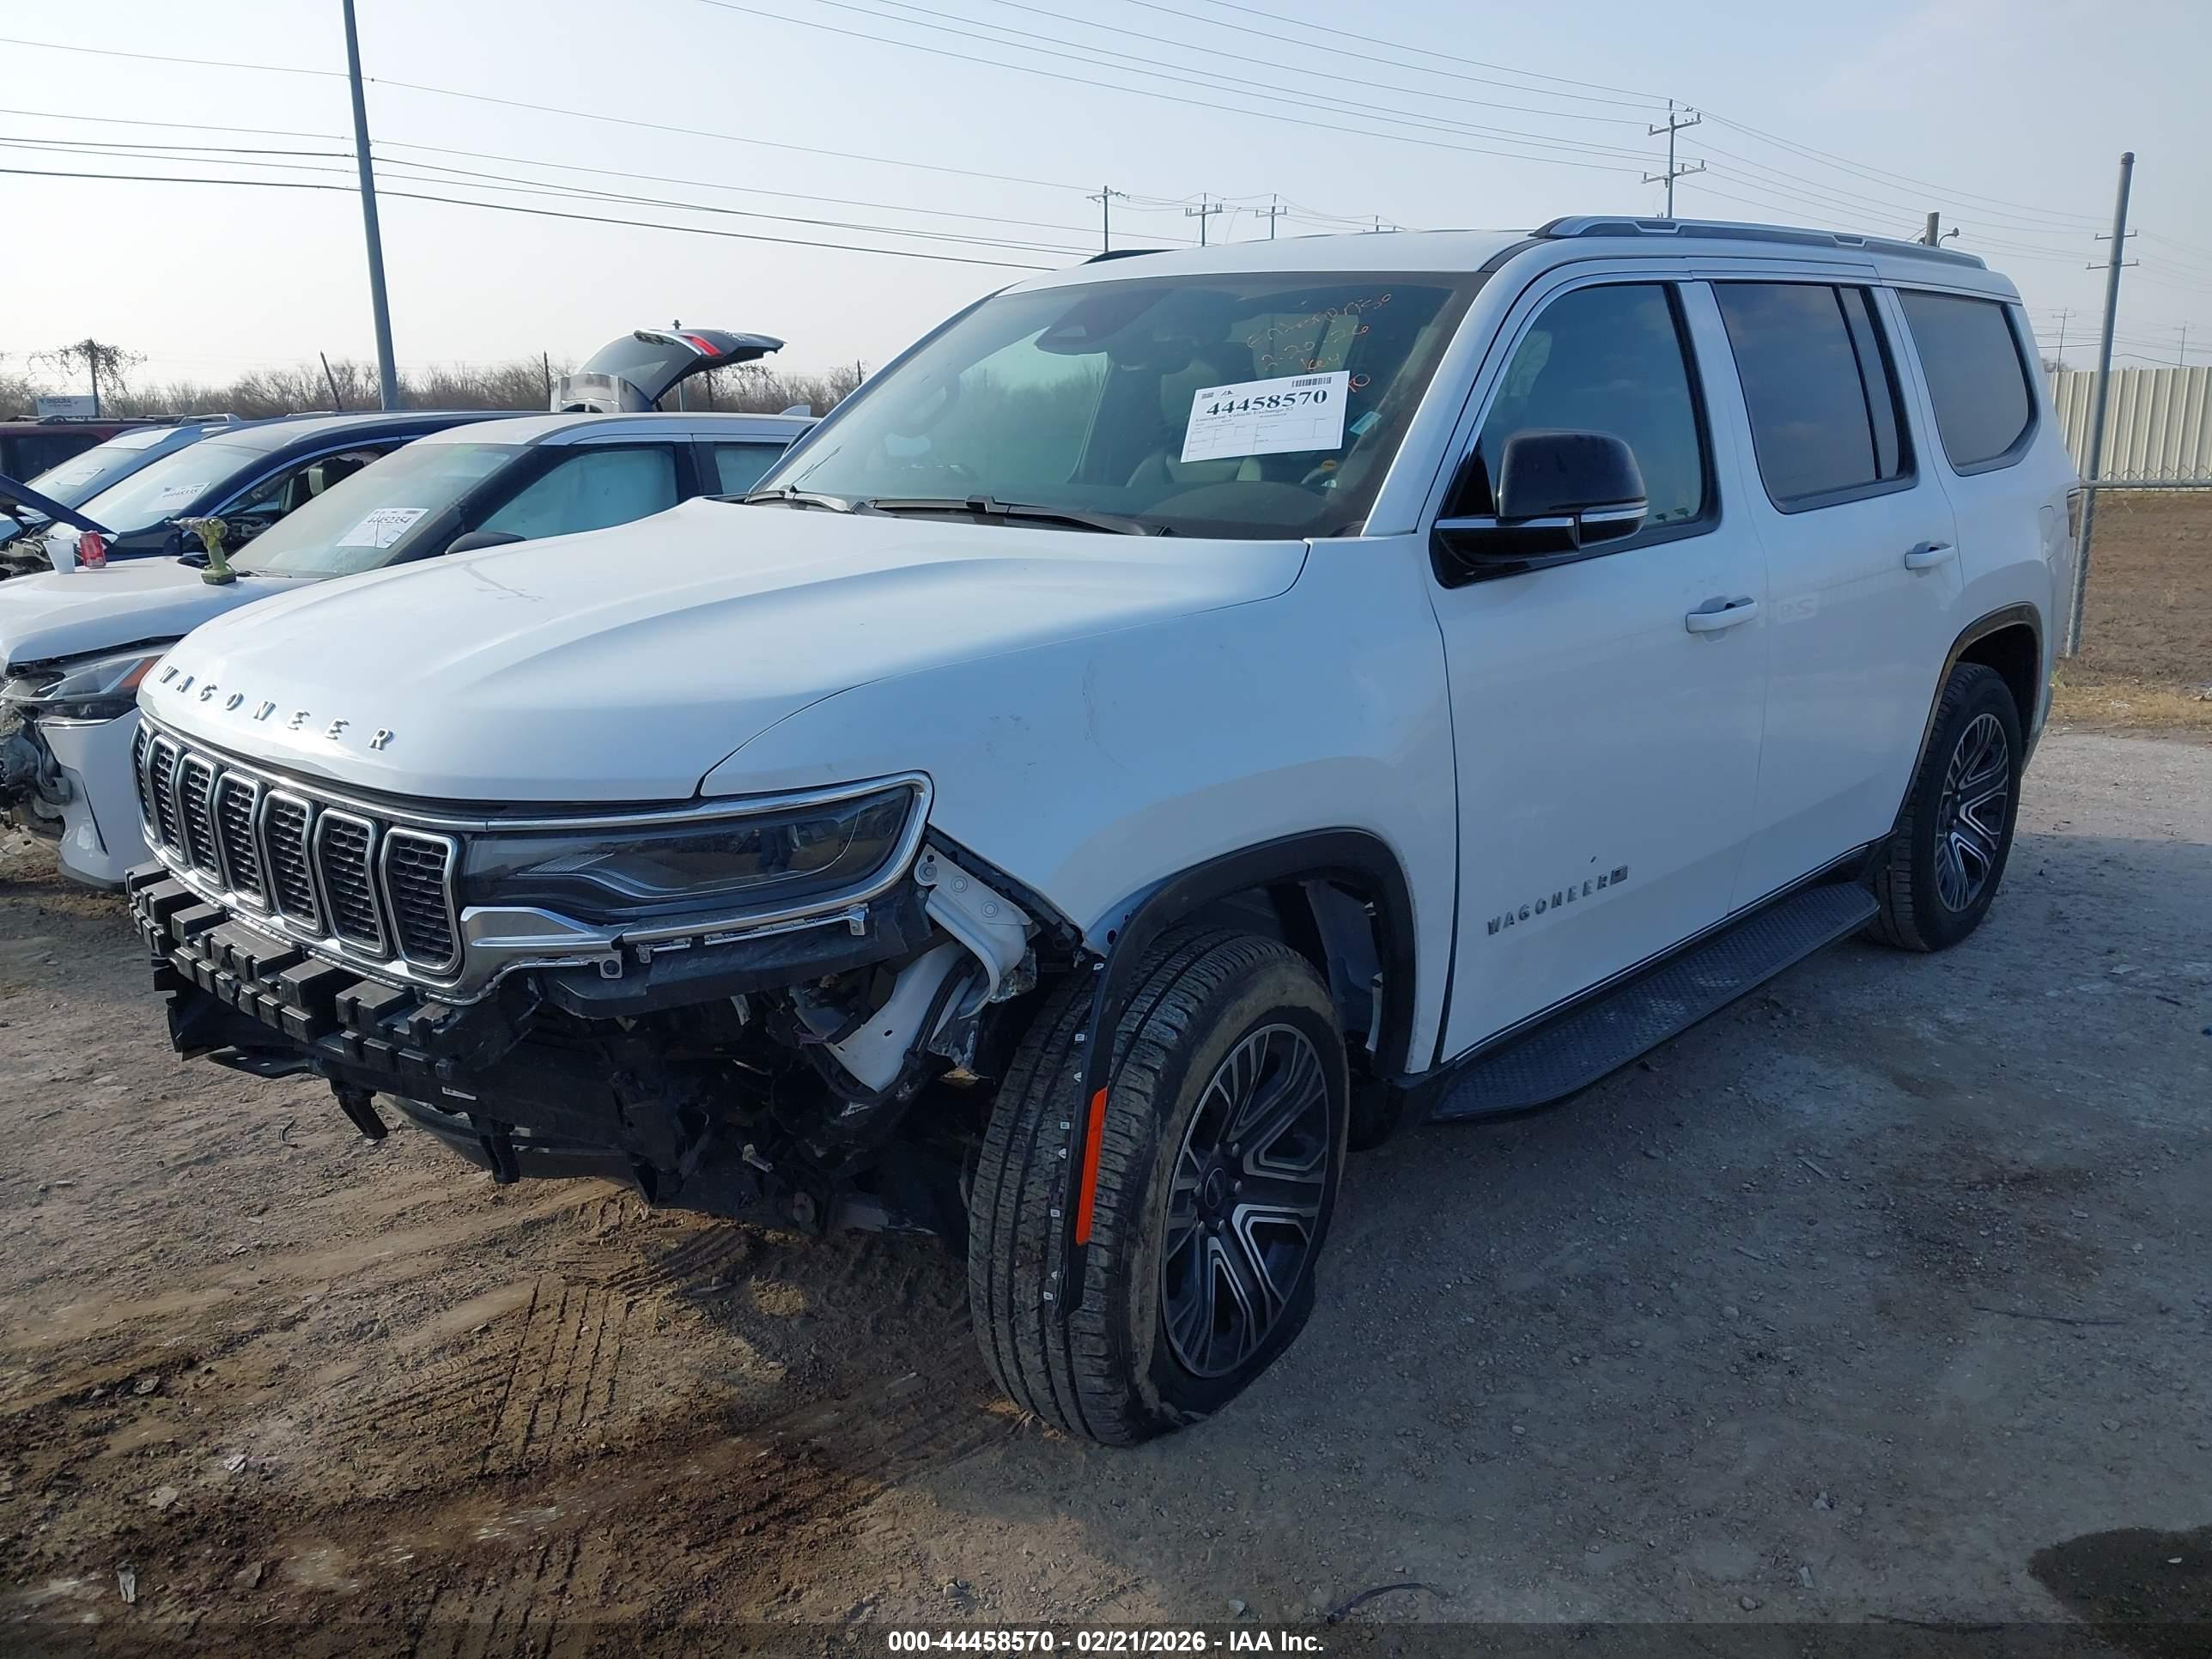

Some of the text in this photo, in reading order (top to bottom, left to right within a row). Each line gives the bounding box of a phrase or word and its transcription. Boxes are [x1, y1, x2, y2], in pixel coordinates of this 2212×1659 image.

[1206, 389, 1328, 416] 44458570
[158, 665, 395, 751] WAGONEER
[1486, 873, 1608, 936] WAGONEER
